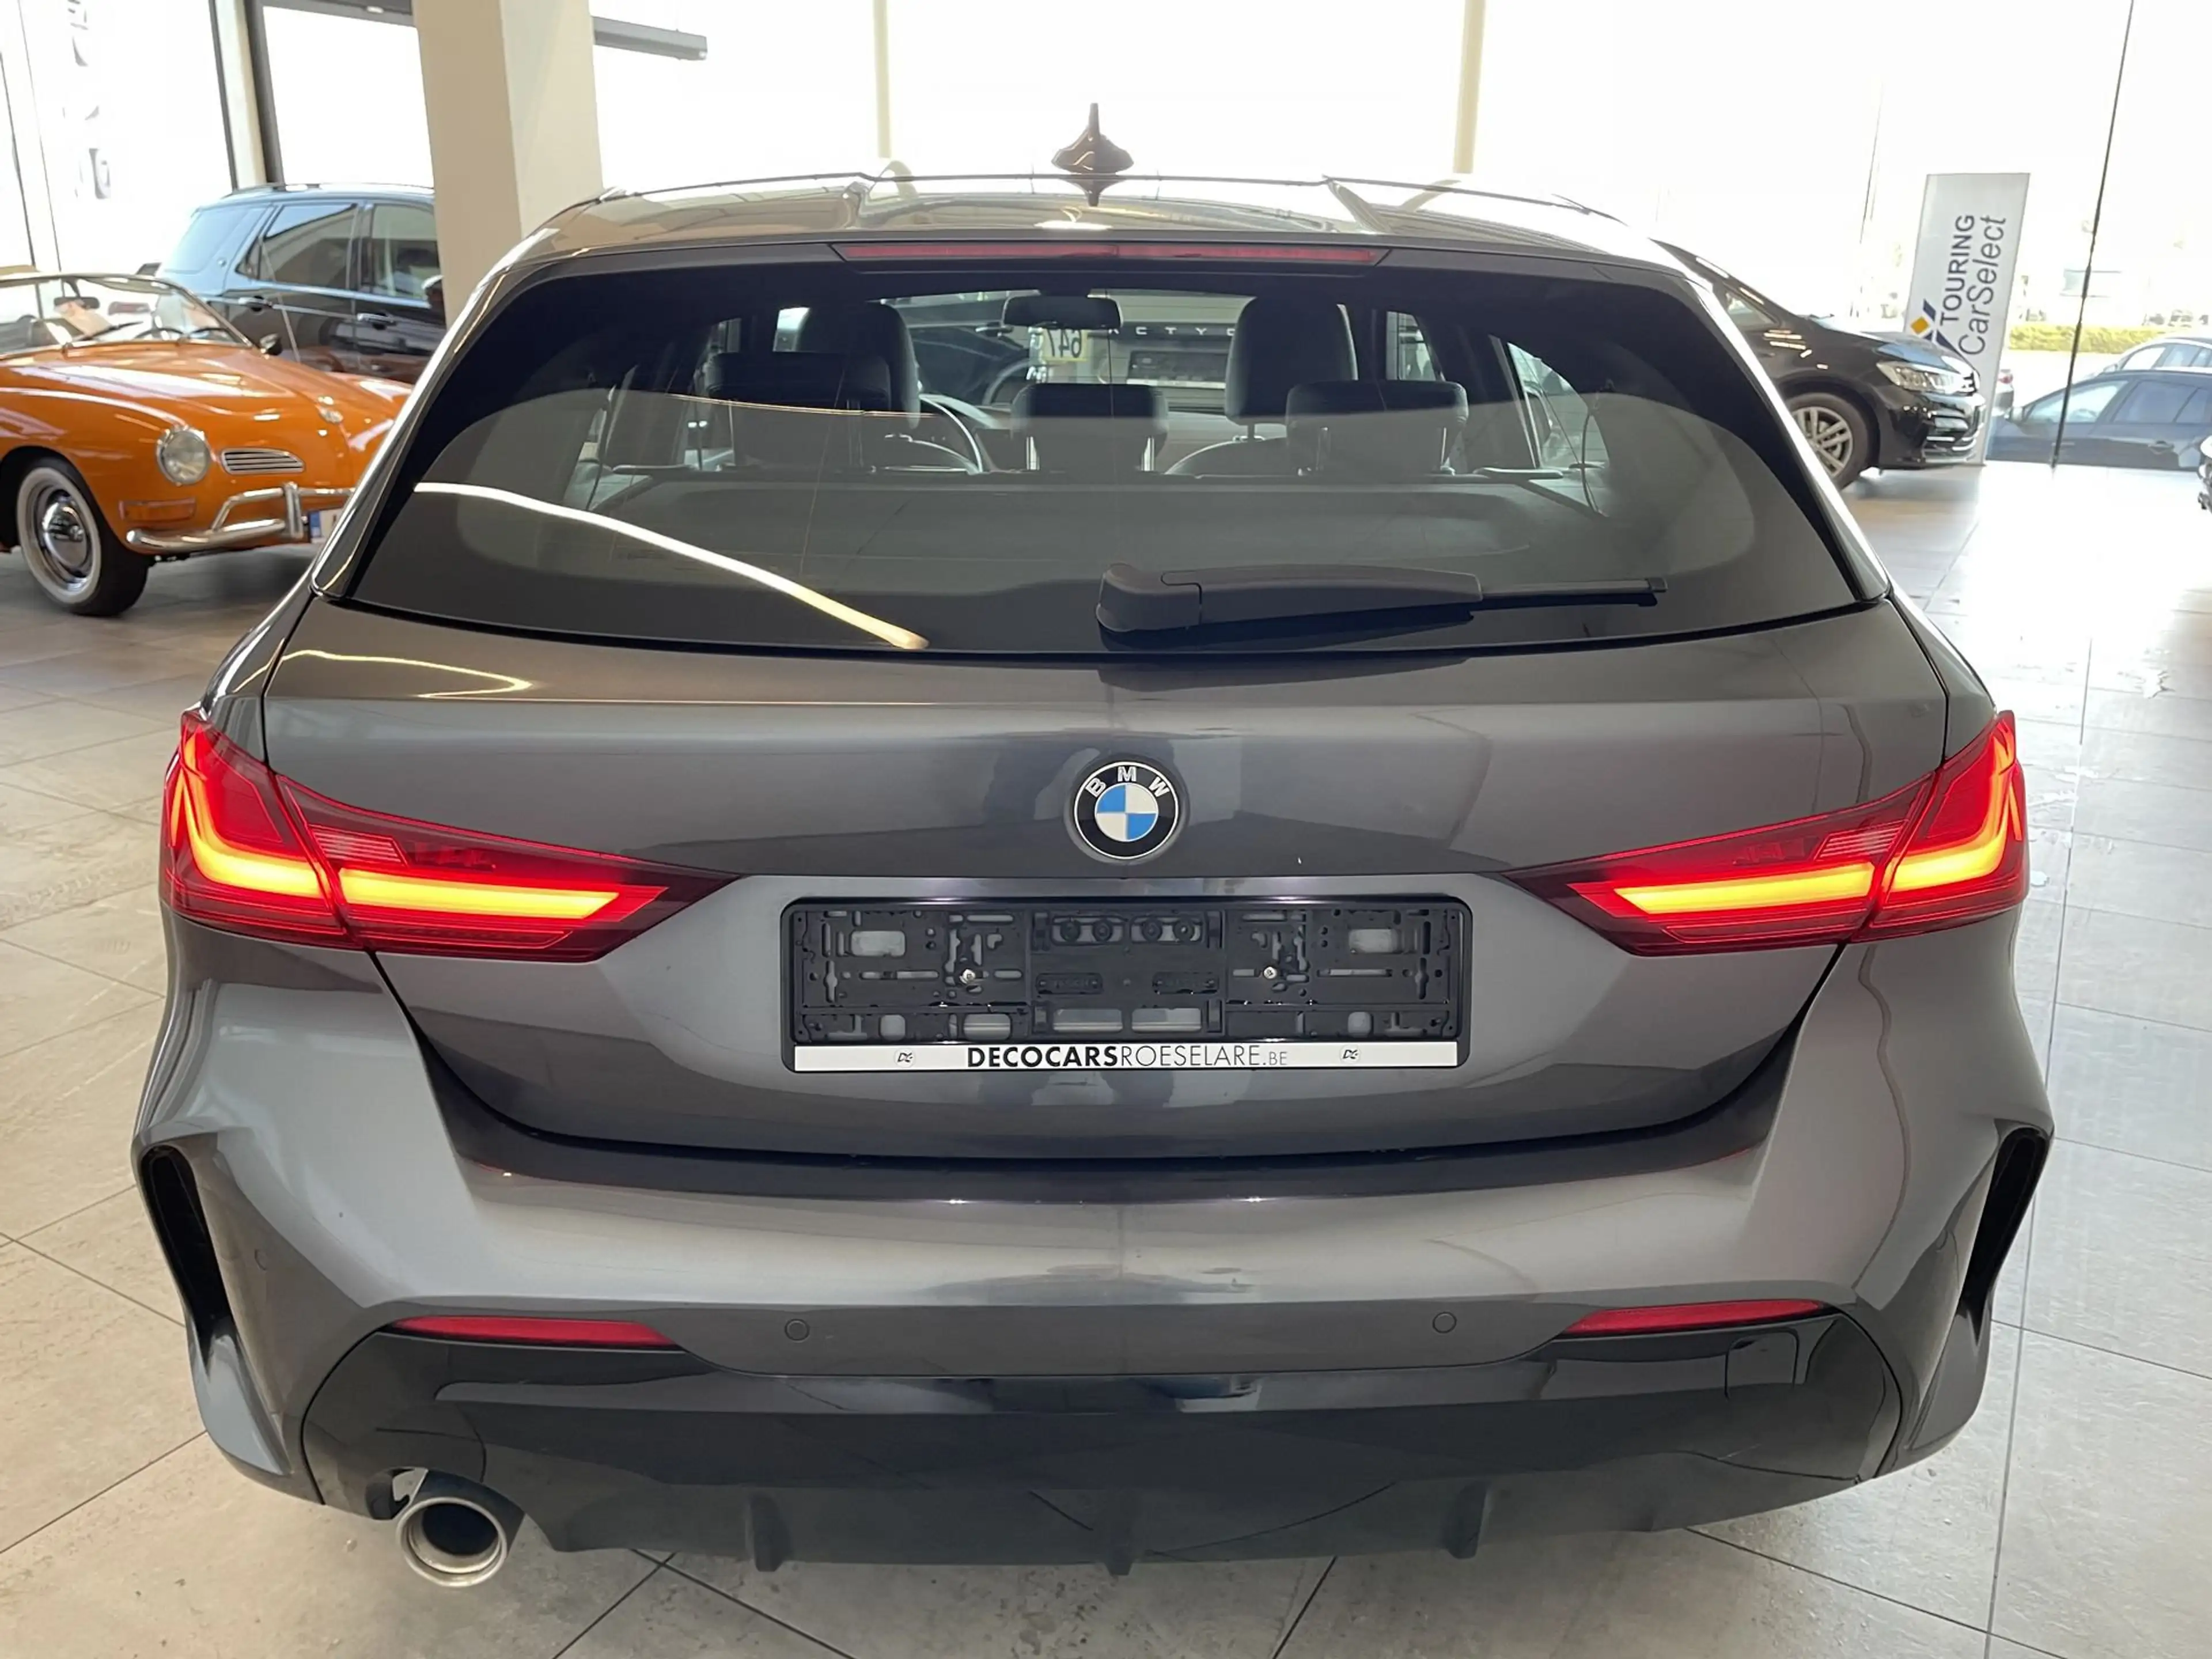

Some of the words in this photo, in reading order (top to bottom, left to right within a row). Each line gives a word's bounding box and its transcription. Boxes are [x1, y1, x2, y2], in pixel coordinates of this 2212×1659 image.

[1940, 214, 1976, 327] TOURING
[1958, 215, 2007, 356] CarSelect
[1085, 766, 1171, 798] BMW
